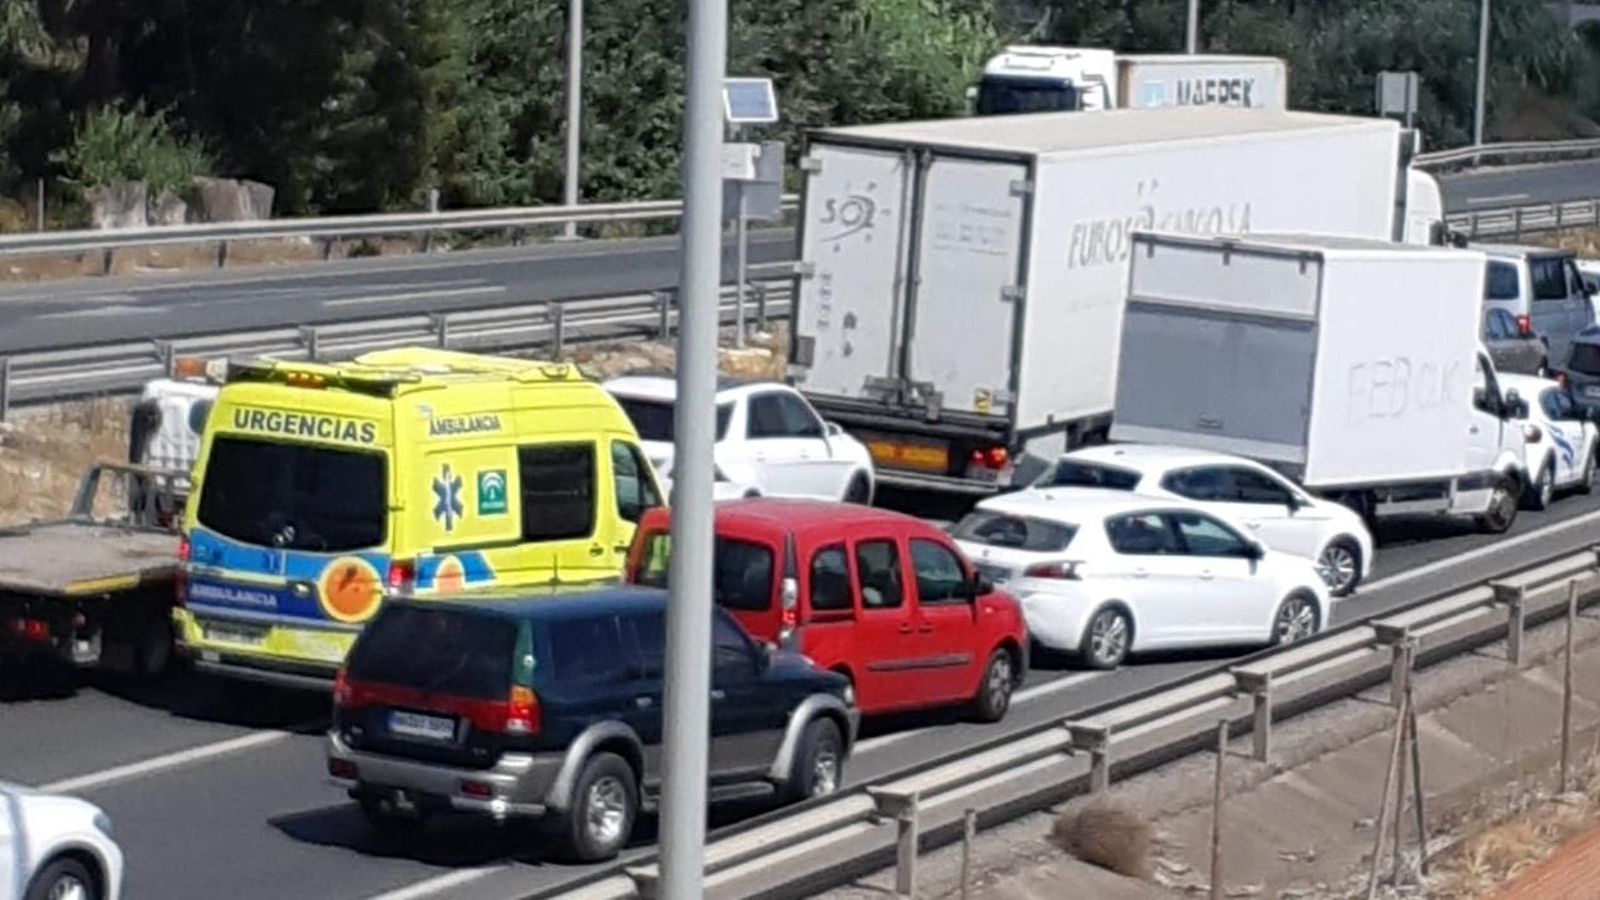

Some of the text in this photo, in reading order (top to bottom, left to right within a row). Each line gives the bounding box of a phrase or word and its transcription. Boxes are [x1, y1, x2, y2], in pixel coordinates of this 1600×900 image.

[233, 408, 376, 444] URGENCIAS
[429, 413, 502, 437] AMBULANCIA
[190, 582, 278, 608] AMBULANCIA
